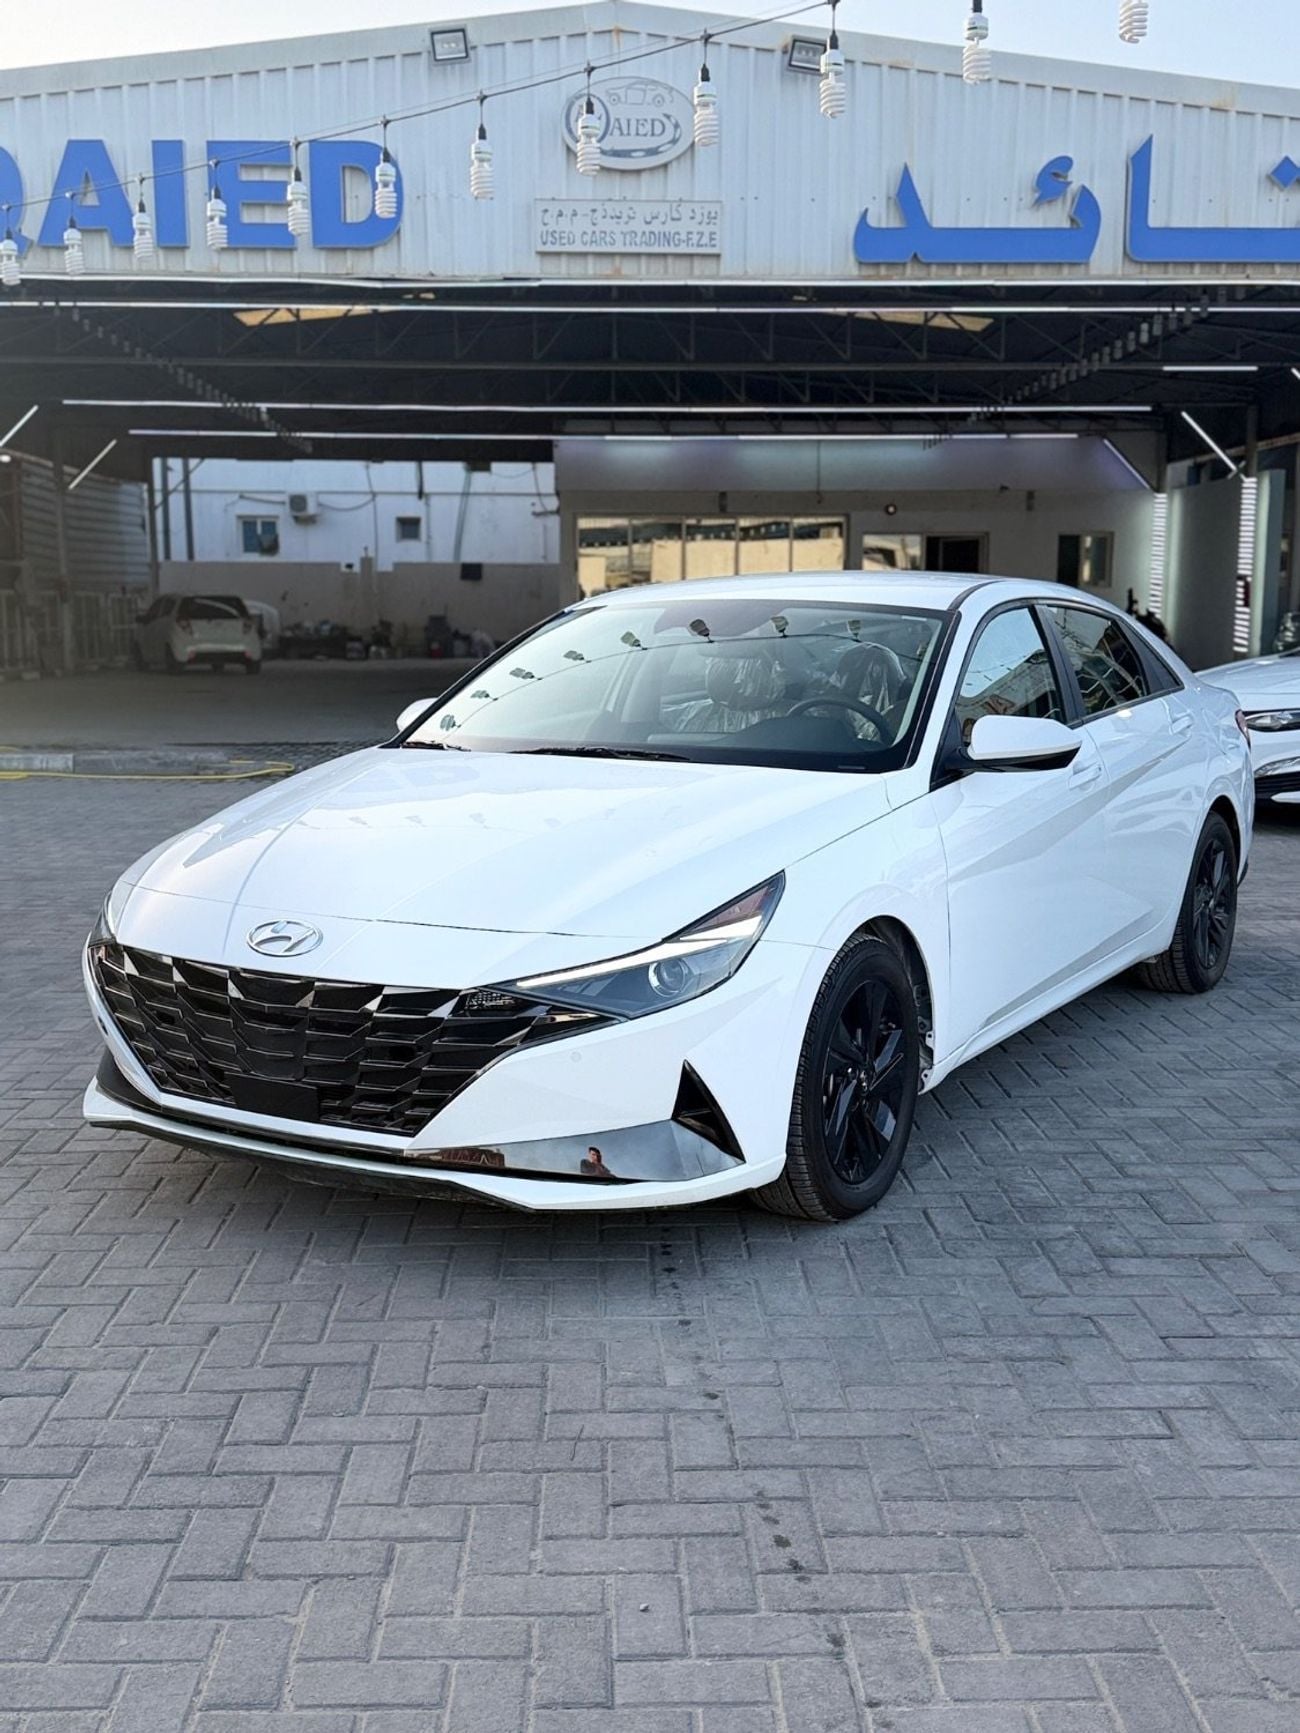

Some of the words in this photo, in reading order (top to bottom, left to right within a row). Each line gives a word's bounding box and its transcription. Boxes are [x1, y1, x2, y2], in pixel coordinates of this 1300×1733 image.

[853, 134, 1300, 263] ائد
[540, 230, 576, 246] USED
[581, 230, 616, 247] CARS
